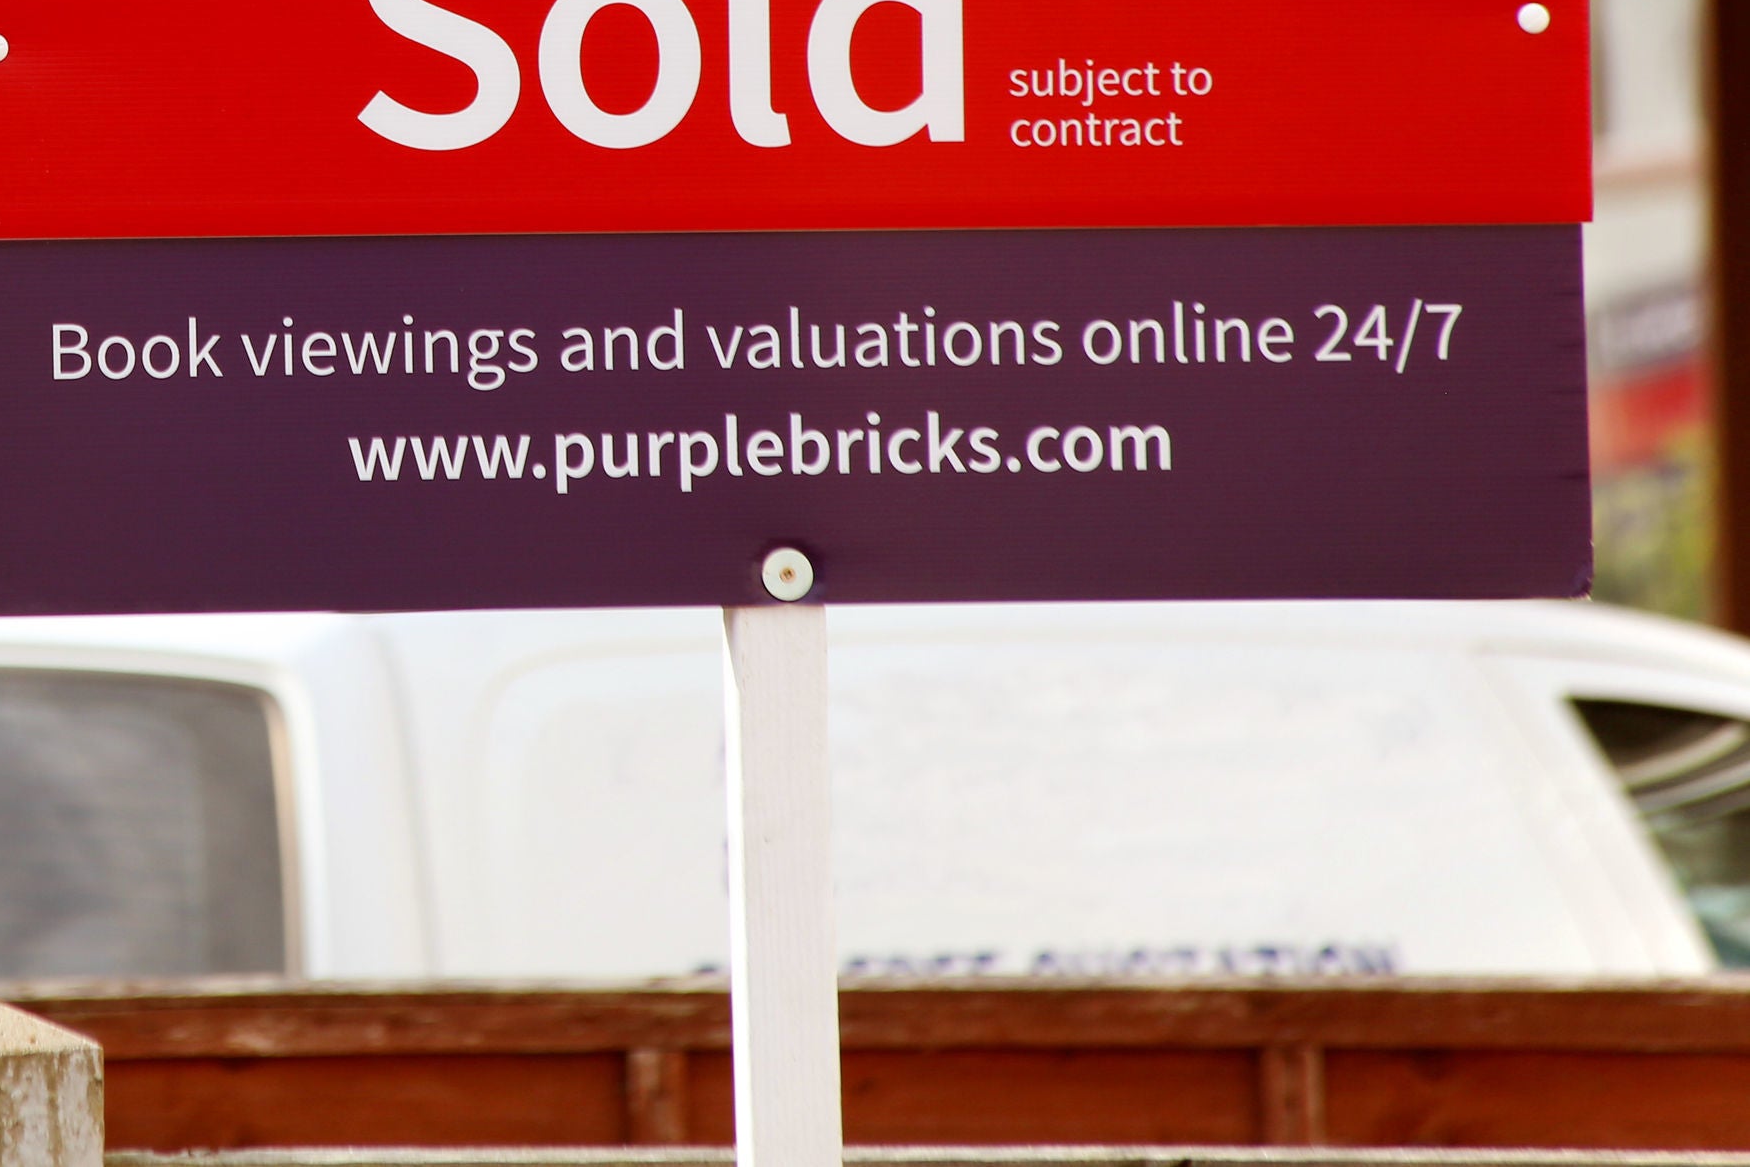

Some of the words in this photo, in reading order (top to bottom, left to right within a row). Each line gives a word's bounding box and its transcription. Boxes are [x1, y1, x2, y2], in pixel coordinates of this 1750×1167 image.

[1009, 58, 1161, 107] subject
[1170, 62, 1213, 96] to
[1009, 111, 1183, 147] contract
[51, 316, 224, 380] Book
[240, 314, 539, 391] viewings
[560, 308, 685, 372] and
[706, 306, 1063, 369] valuations
[1083, 301, 1294, 365] online
[1314, 298, 1463, 374] 24/7
[348, 411, 1172, 494] www.purplebricks.com
